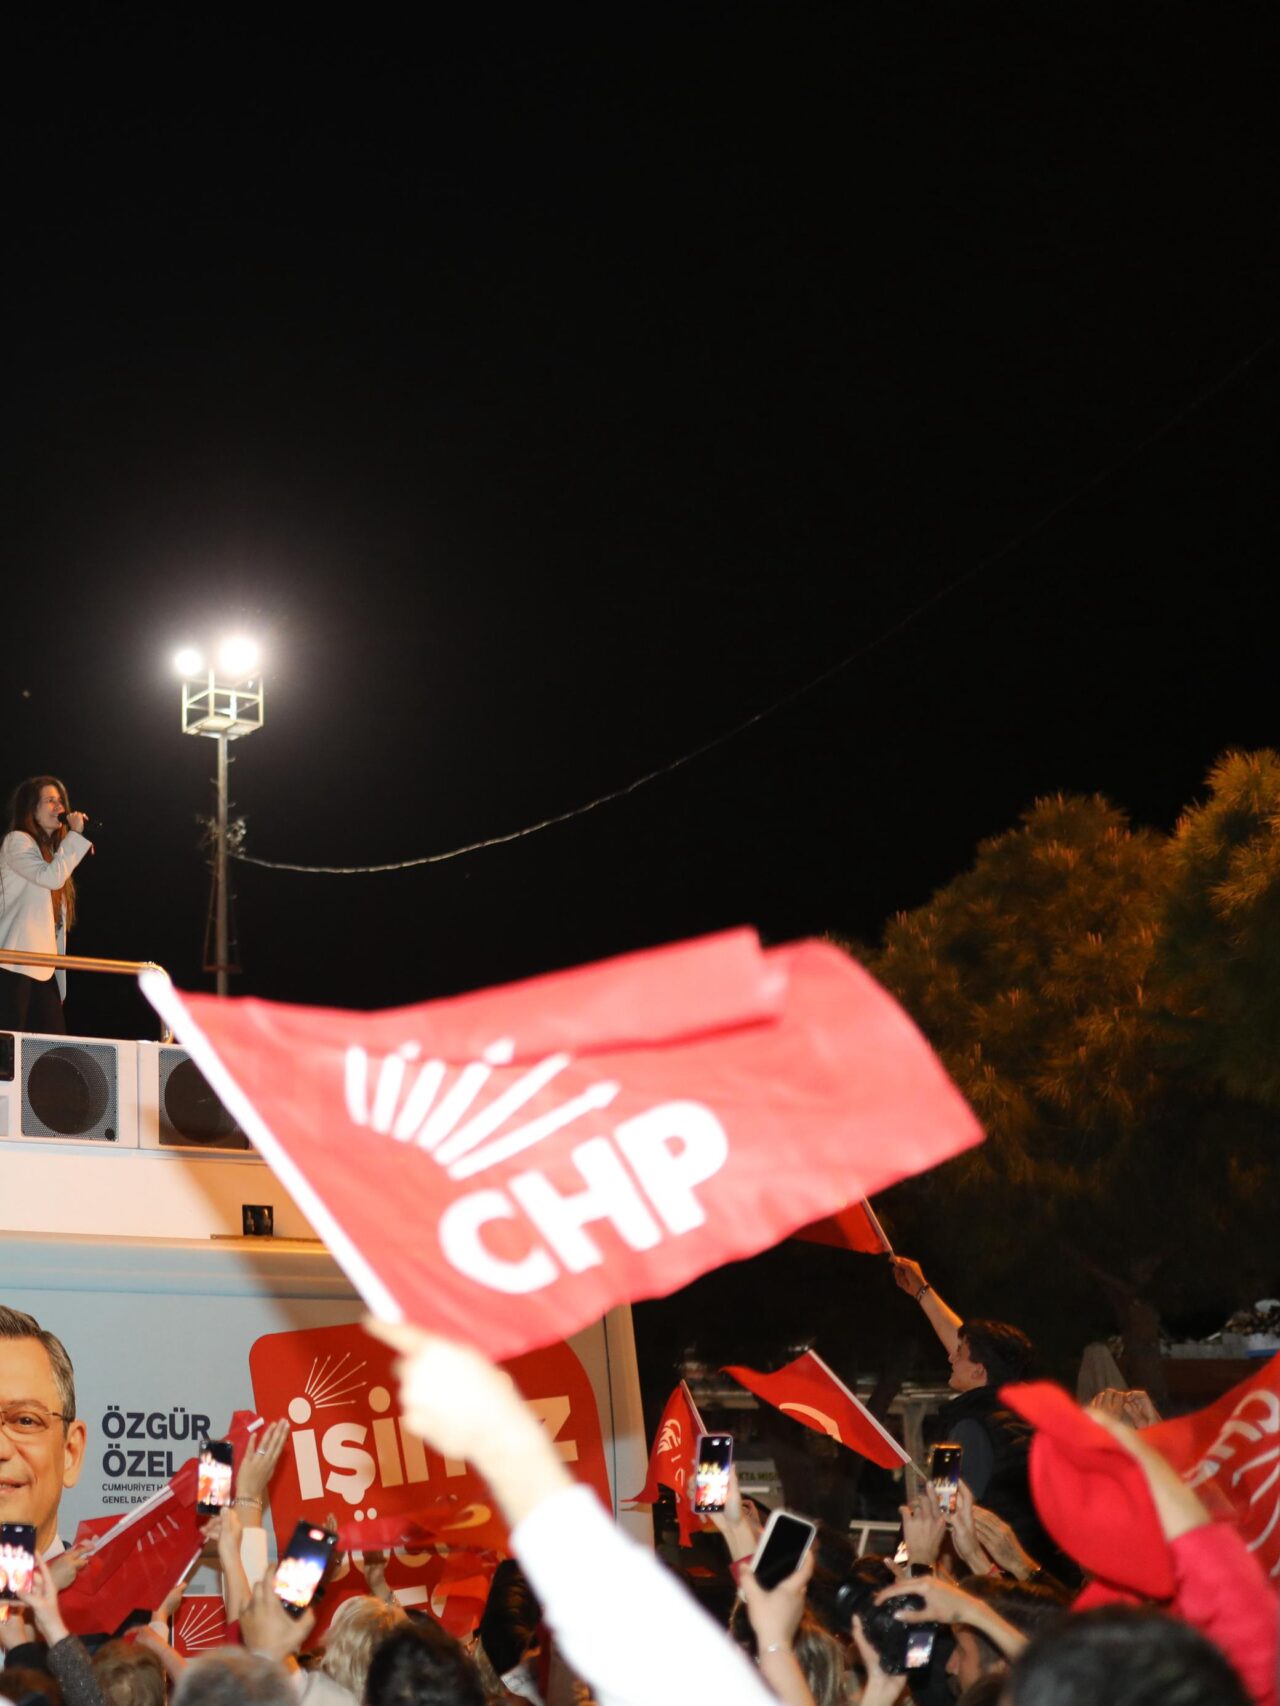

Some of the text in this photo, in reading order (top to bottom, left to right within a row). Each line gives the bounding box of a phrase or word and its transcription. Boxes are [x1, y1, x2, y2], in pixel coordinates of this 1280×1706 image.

[437, 1099, 729, 1294] CHP
[101, 1405, 211, 1441] ÖZGÜR
[102, 1443, 178, 1477] ÖZEL
[102, 1482, 155, 1492] CUMHURİYET
[102, 1495, 129, 1504] GENEL
